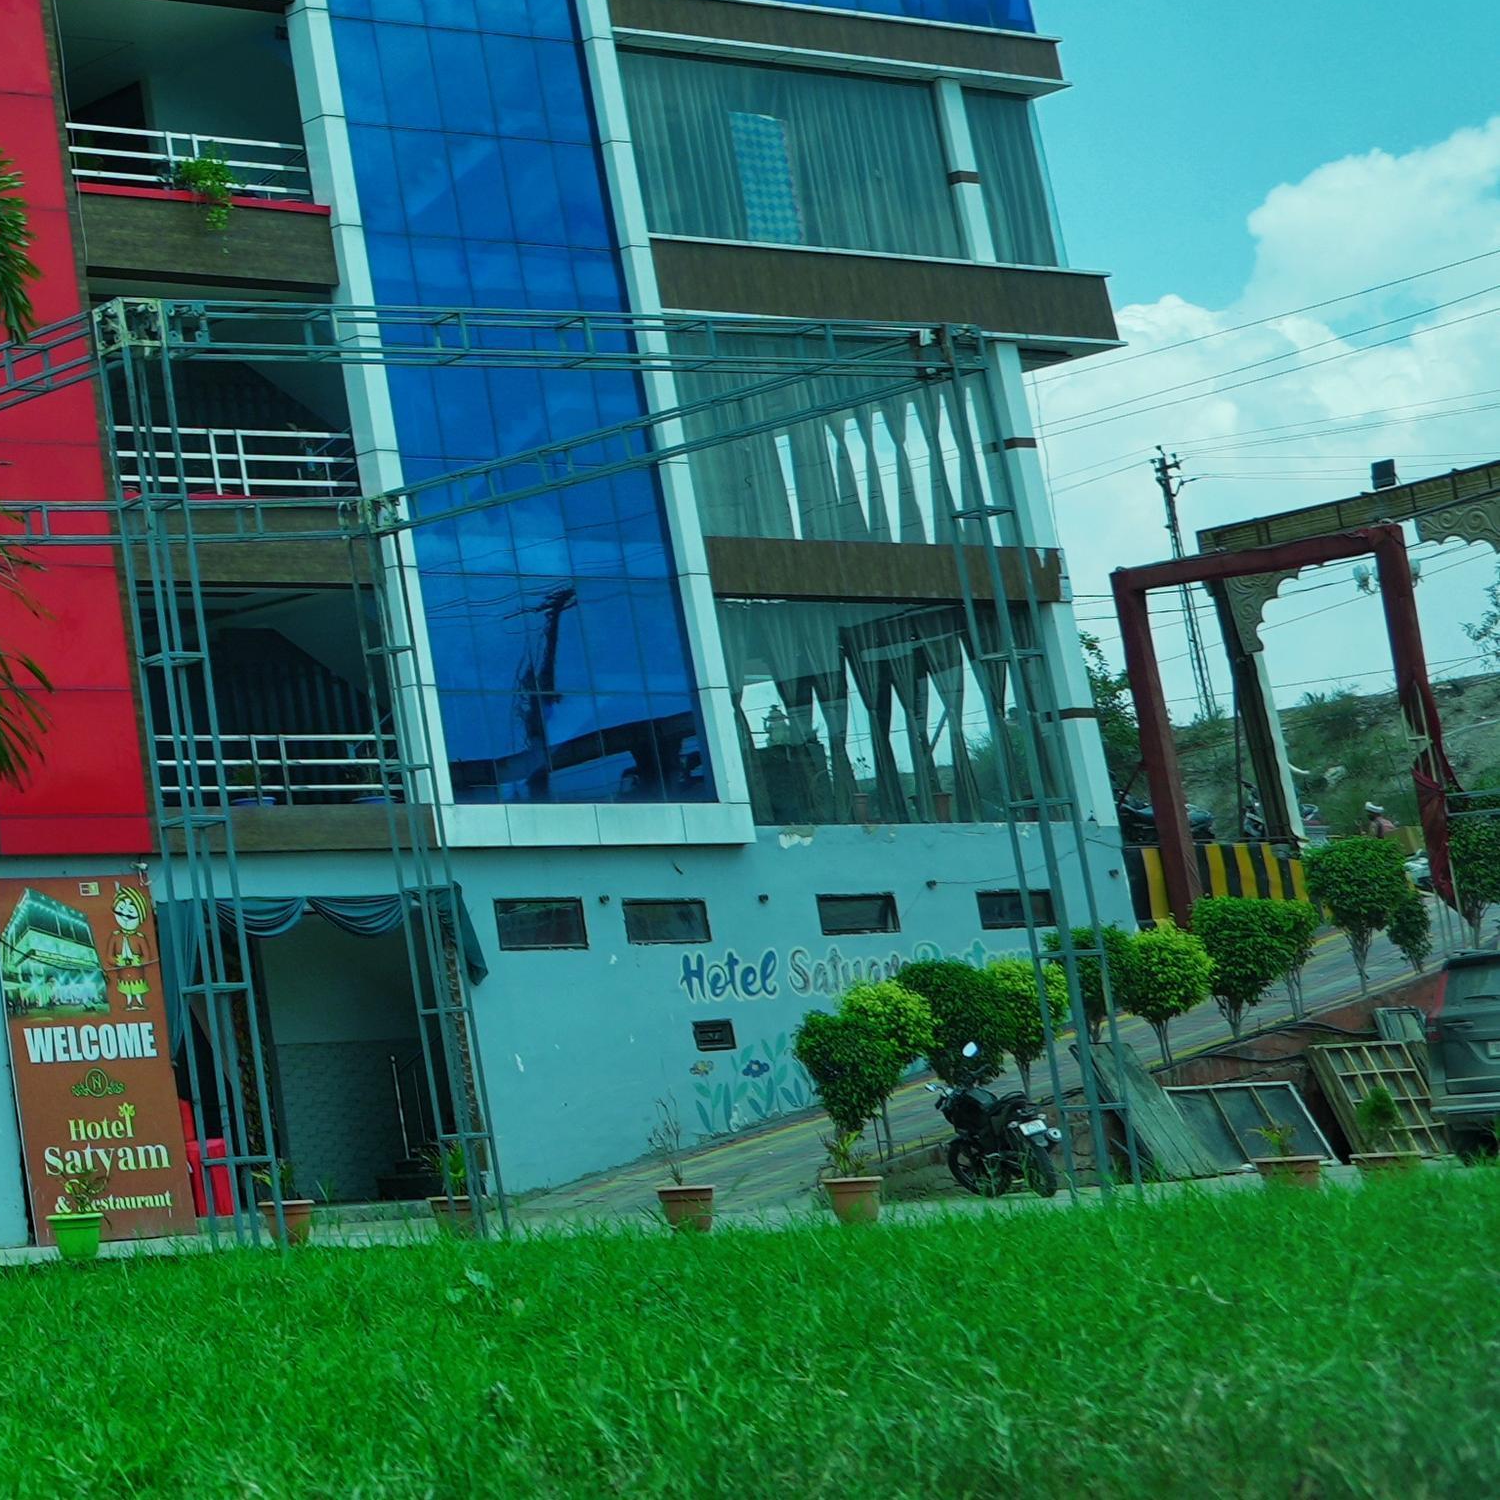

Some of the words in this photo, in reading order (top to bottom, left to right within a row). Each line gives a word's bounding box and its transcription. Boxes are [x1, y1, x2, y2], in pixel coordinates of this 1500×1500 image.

[681, 949, 778, 1000] Hotel
[23, 1022, 158, 1063] WELCOME
[68, 1106, 134, 1141] Hotel
[44, 1143, 171, 1183] Satyam
[54, 1196, 72, 1214] &
